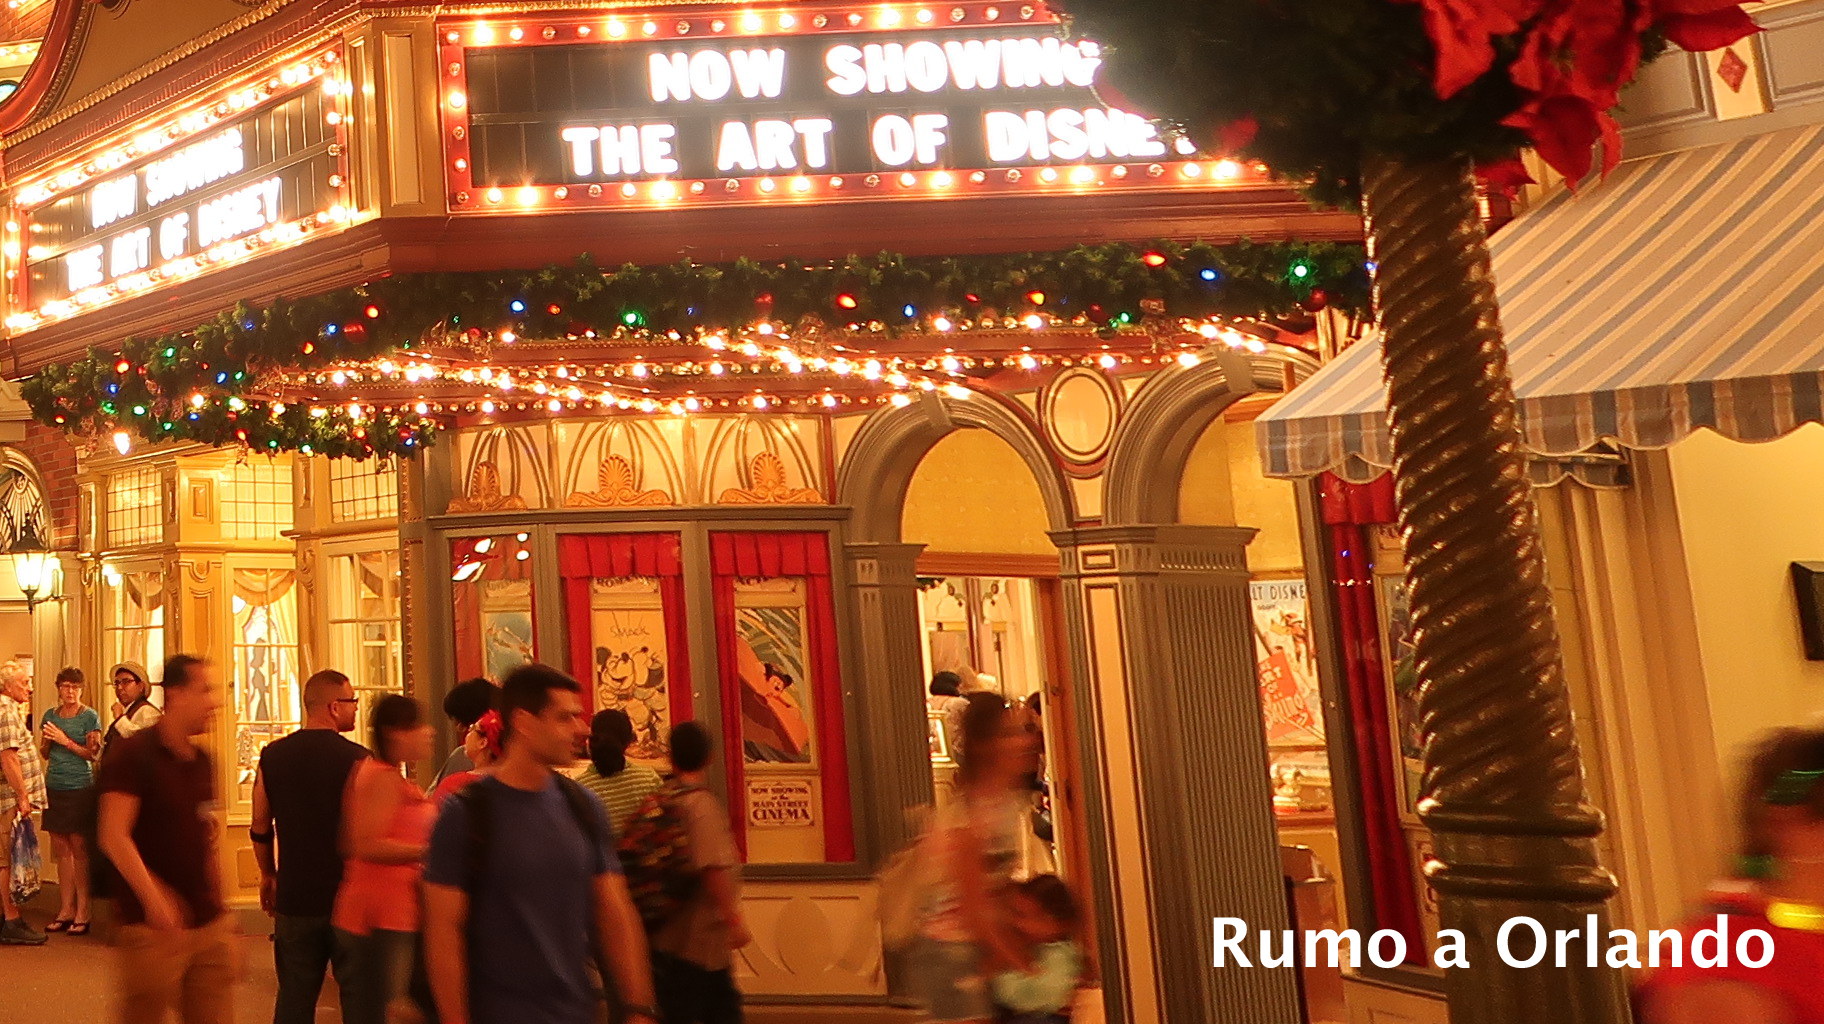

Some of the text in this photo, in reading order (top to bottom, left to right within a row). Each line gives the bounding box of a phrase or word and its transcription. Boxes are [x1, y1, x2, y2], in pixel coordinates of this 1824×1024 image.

[649, 36, 1102, 102] NOW SHOWING
[562, 107, 1196, 176] THE ART OF DISNE
[160, 212, 188, 260] OF
[1270, 584, 1305, 599] DISNE
[752, 808, 811, 821] CINEMA
